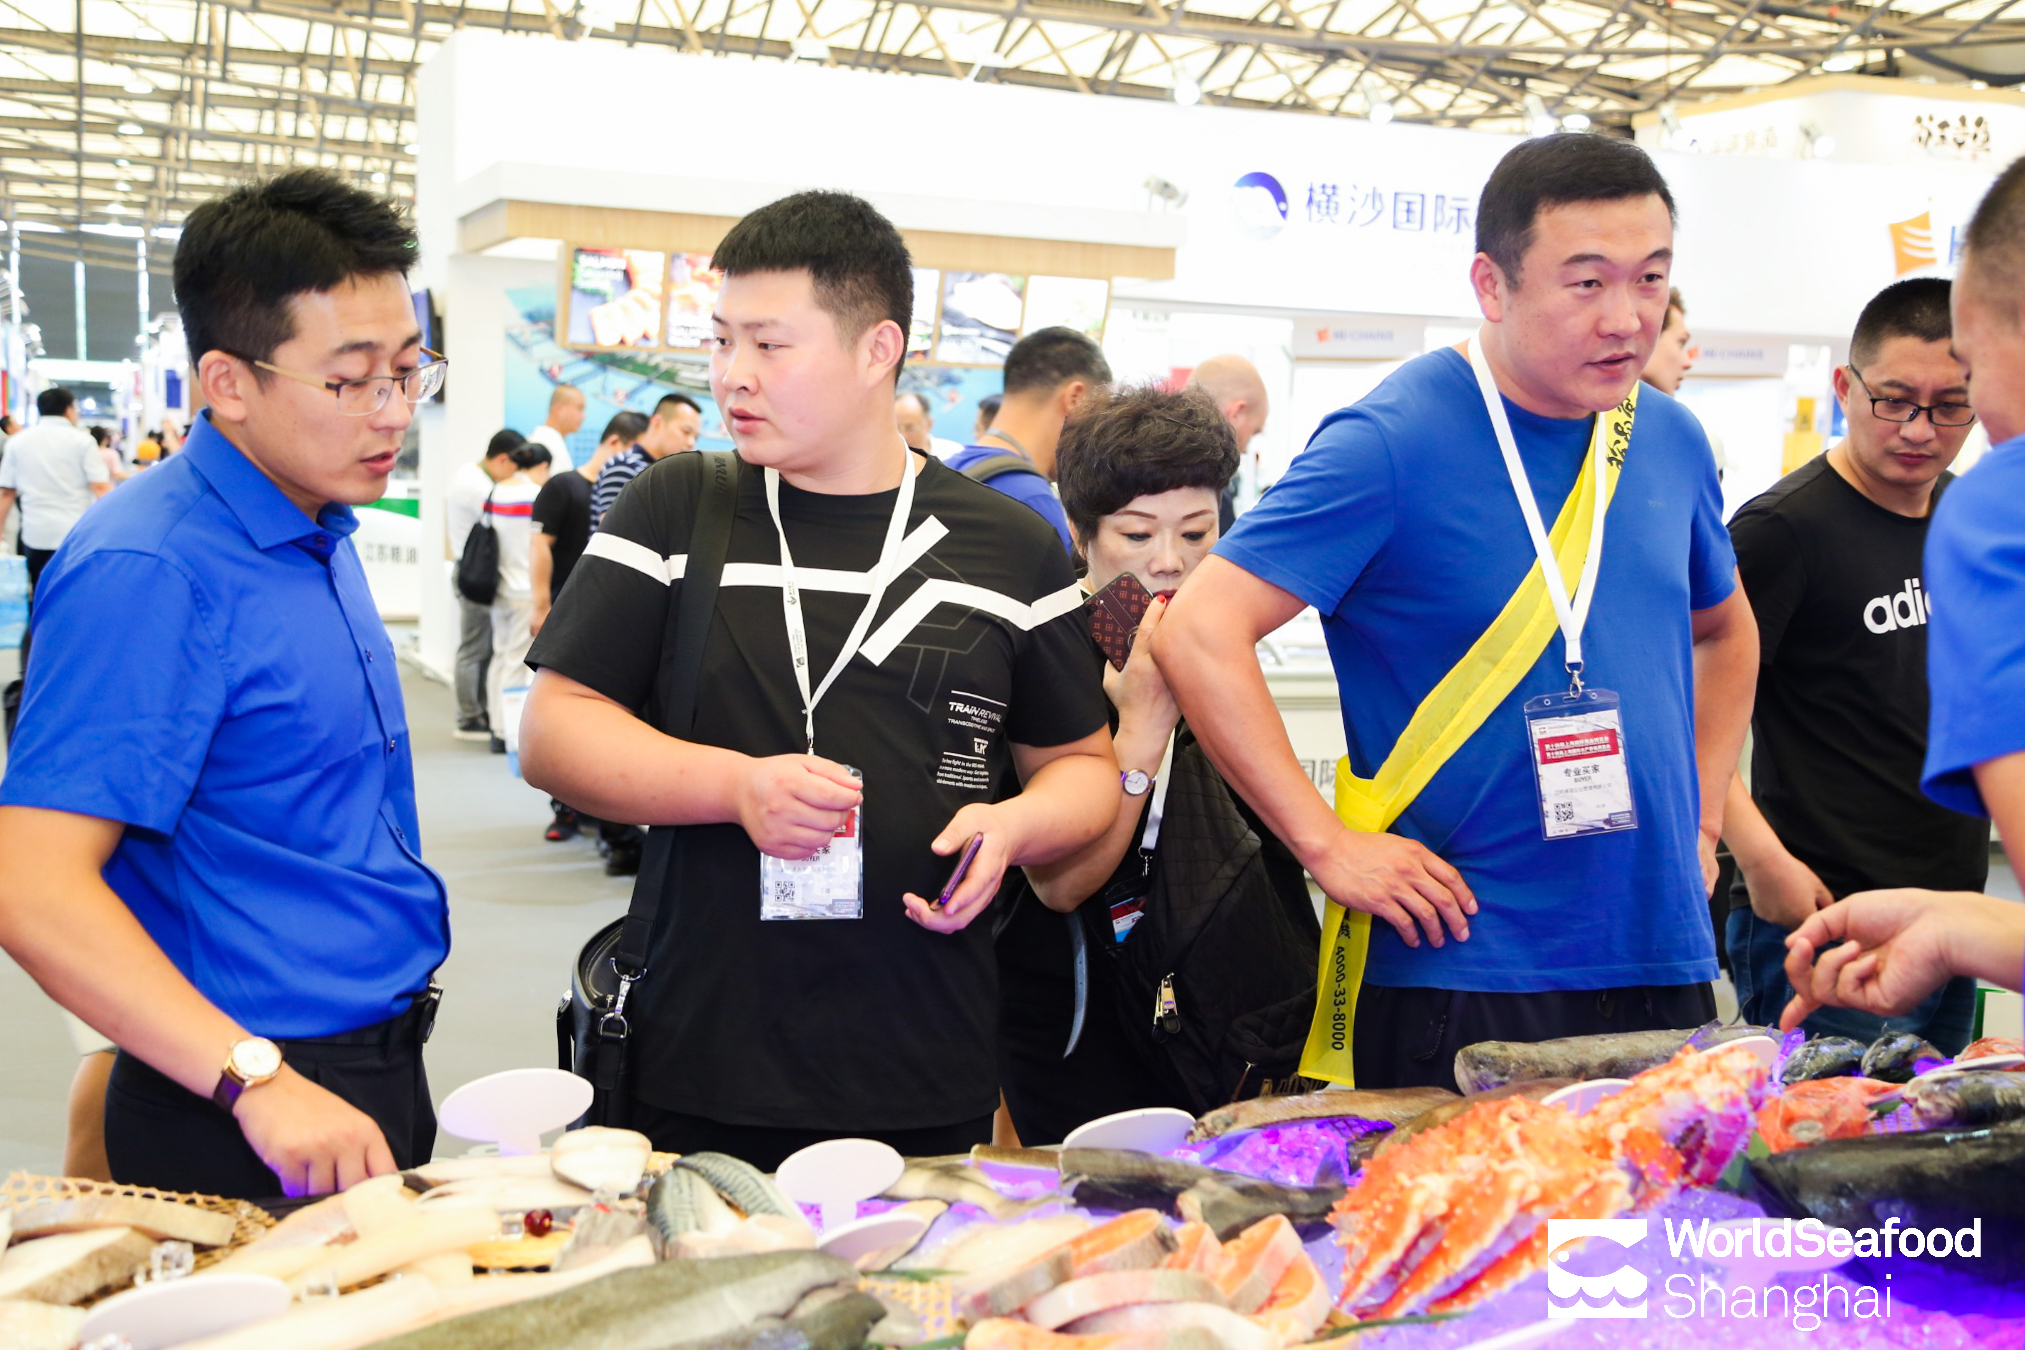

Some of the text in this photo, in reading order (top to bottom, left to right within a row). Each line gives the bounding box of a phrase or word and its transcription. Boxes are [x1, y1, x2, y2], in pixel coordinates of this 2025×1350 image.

[1305, 181, 1472, 234] 横沙国际
[948, 701, 980, 716] TRAIN
[1563, 764, 1600, 777] 专业买家
[1331, 945, 1346, 1051] 4000-33-8000
